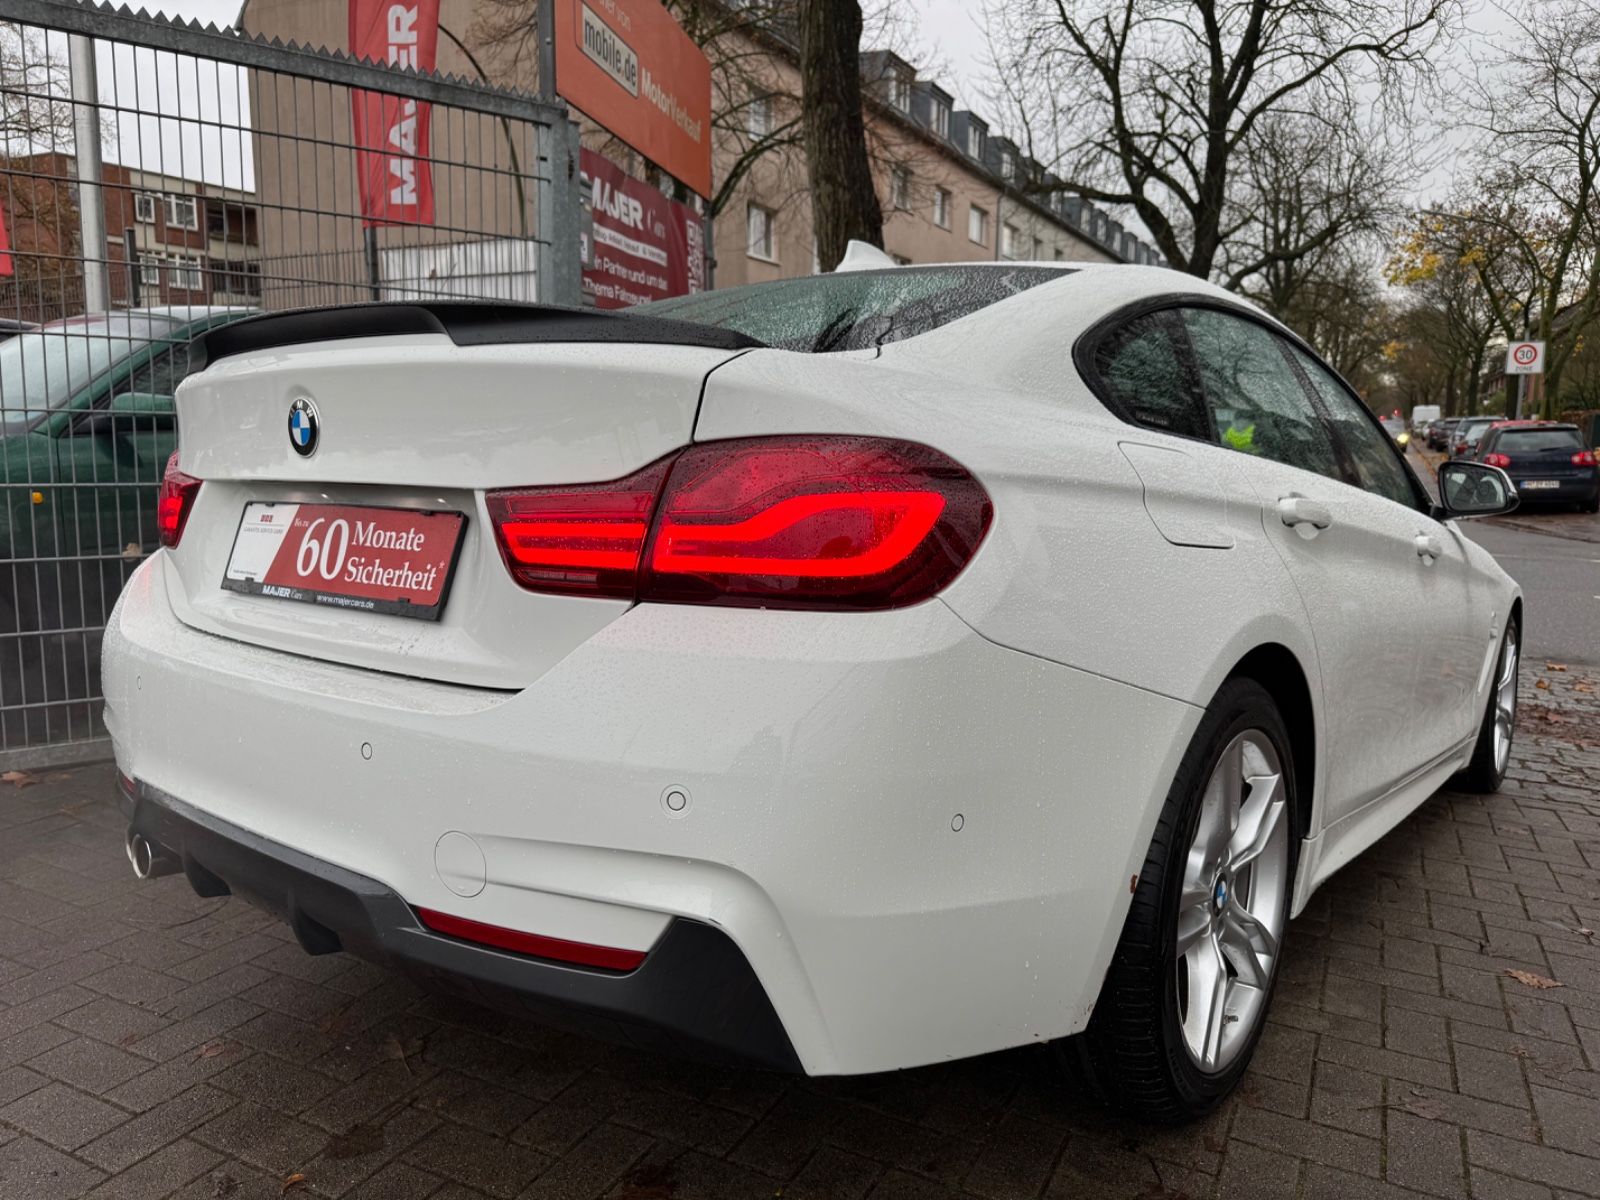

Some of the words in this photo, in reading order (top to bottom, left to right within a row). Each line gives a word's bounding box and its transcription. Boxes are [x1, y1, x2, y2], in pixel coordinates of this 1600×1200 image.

[584, 18, 637, 88] mobile.de
[1518, 350, 1533, 360] 30
[351, 520, 425, 552] Monate
[296, 517, 350, 581] 60
[261, 584, 291, 598] MAJER
[316, 594, 375, 609] www.majercars.de
